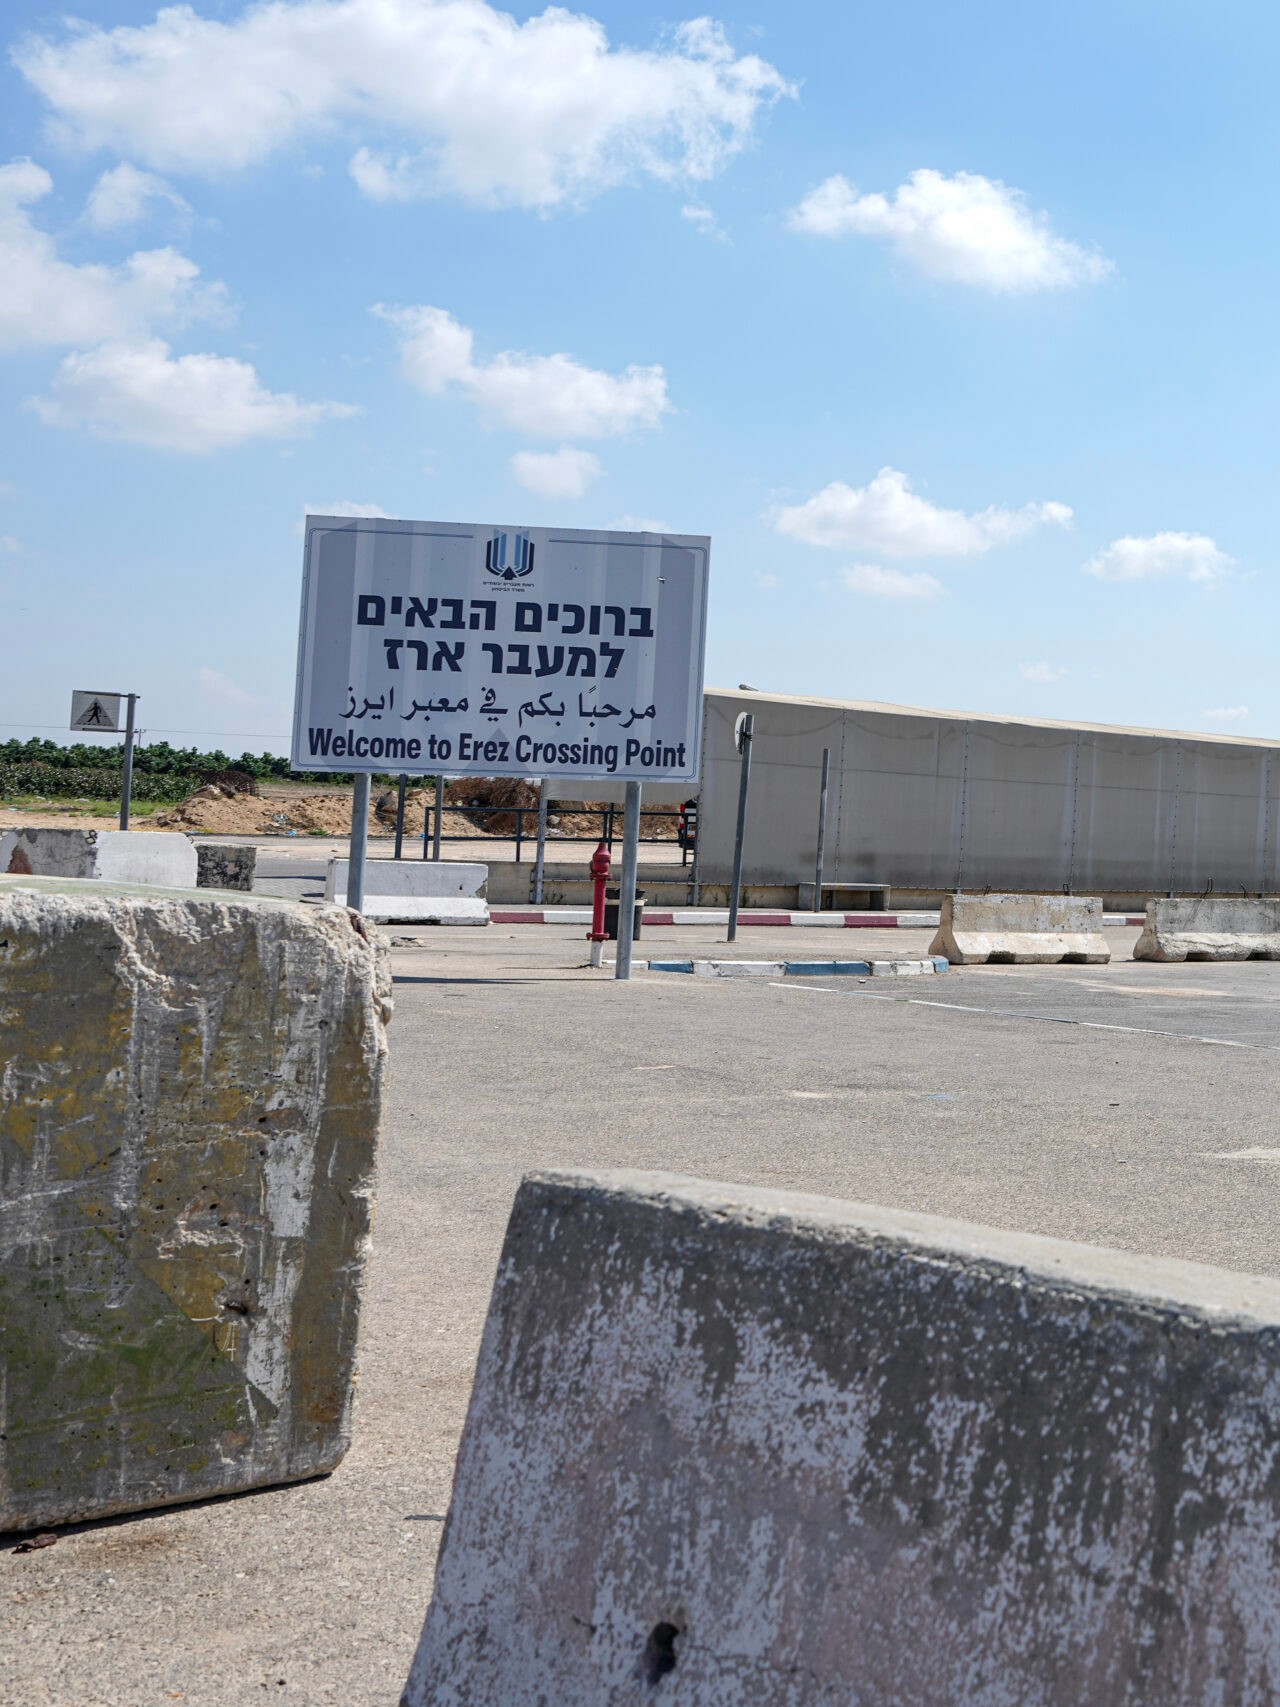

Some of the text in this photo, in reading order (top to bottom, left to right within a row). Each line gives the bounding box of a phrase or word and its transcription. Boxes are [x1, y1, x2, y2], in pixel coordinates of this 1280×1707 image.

[357, 594, 654, 637] ברוכים הבאים
[384, 638, 625, 678] למעבר ארז
[338, 686, 395, 720] ايرز
[400, 697, 469, 721] معبر
[479, 686, 509, 722] في
[518, 692, 565, 728] بكم
[308, 727, 686, 772] Welcome to Erez Crossing Point
